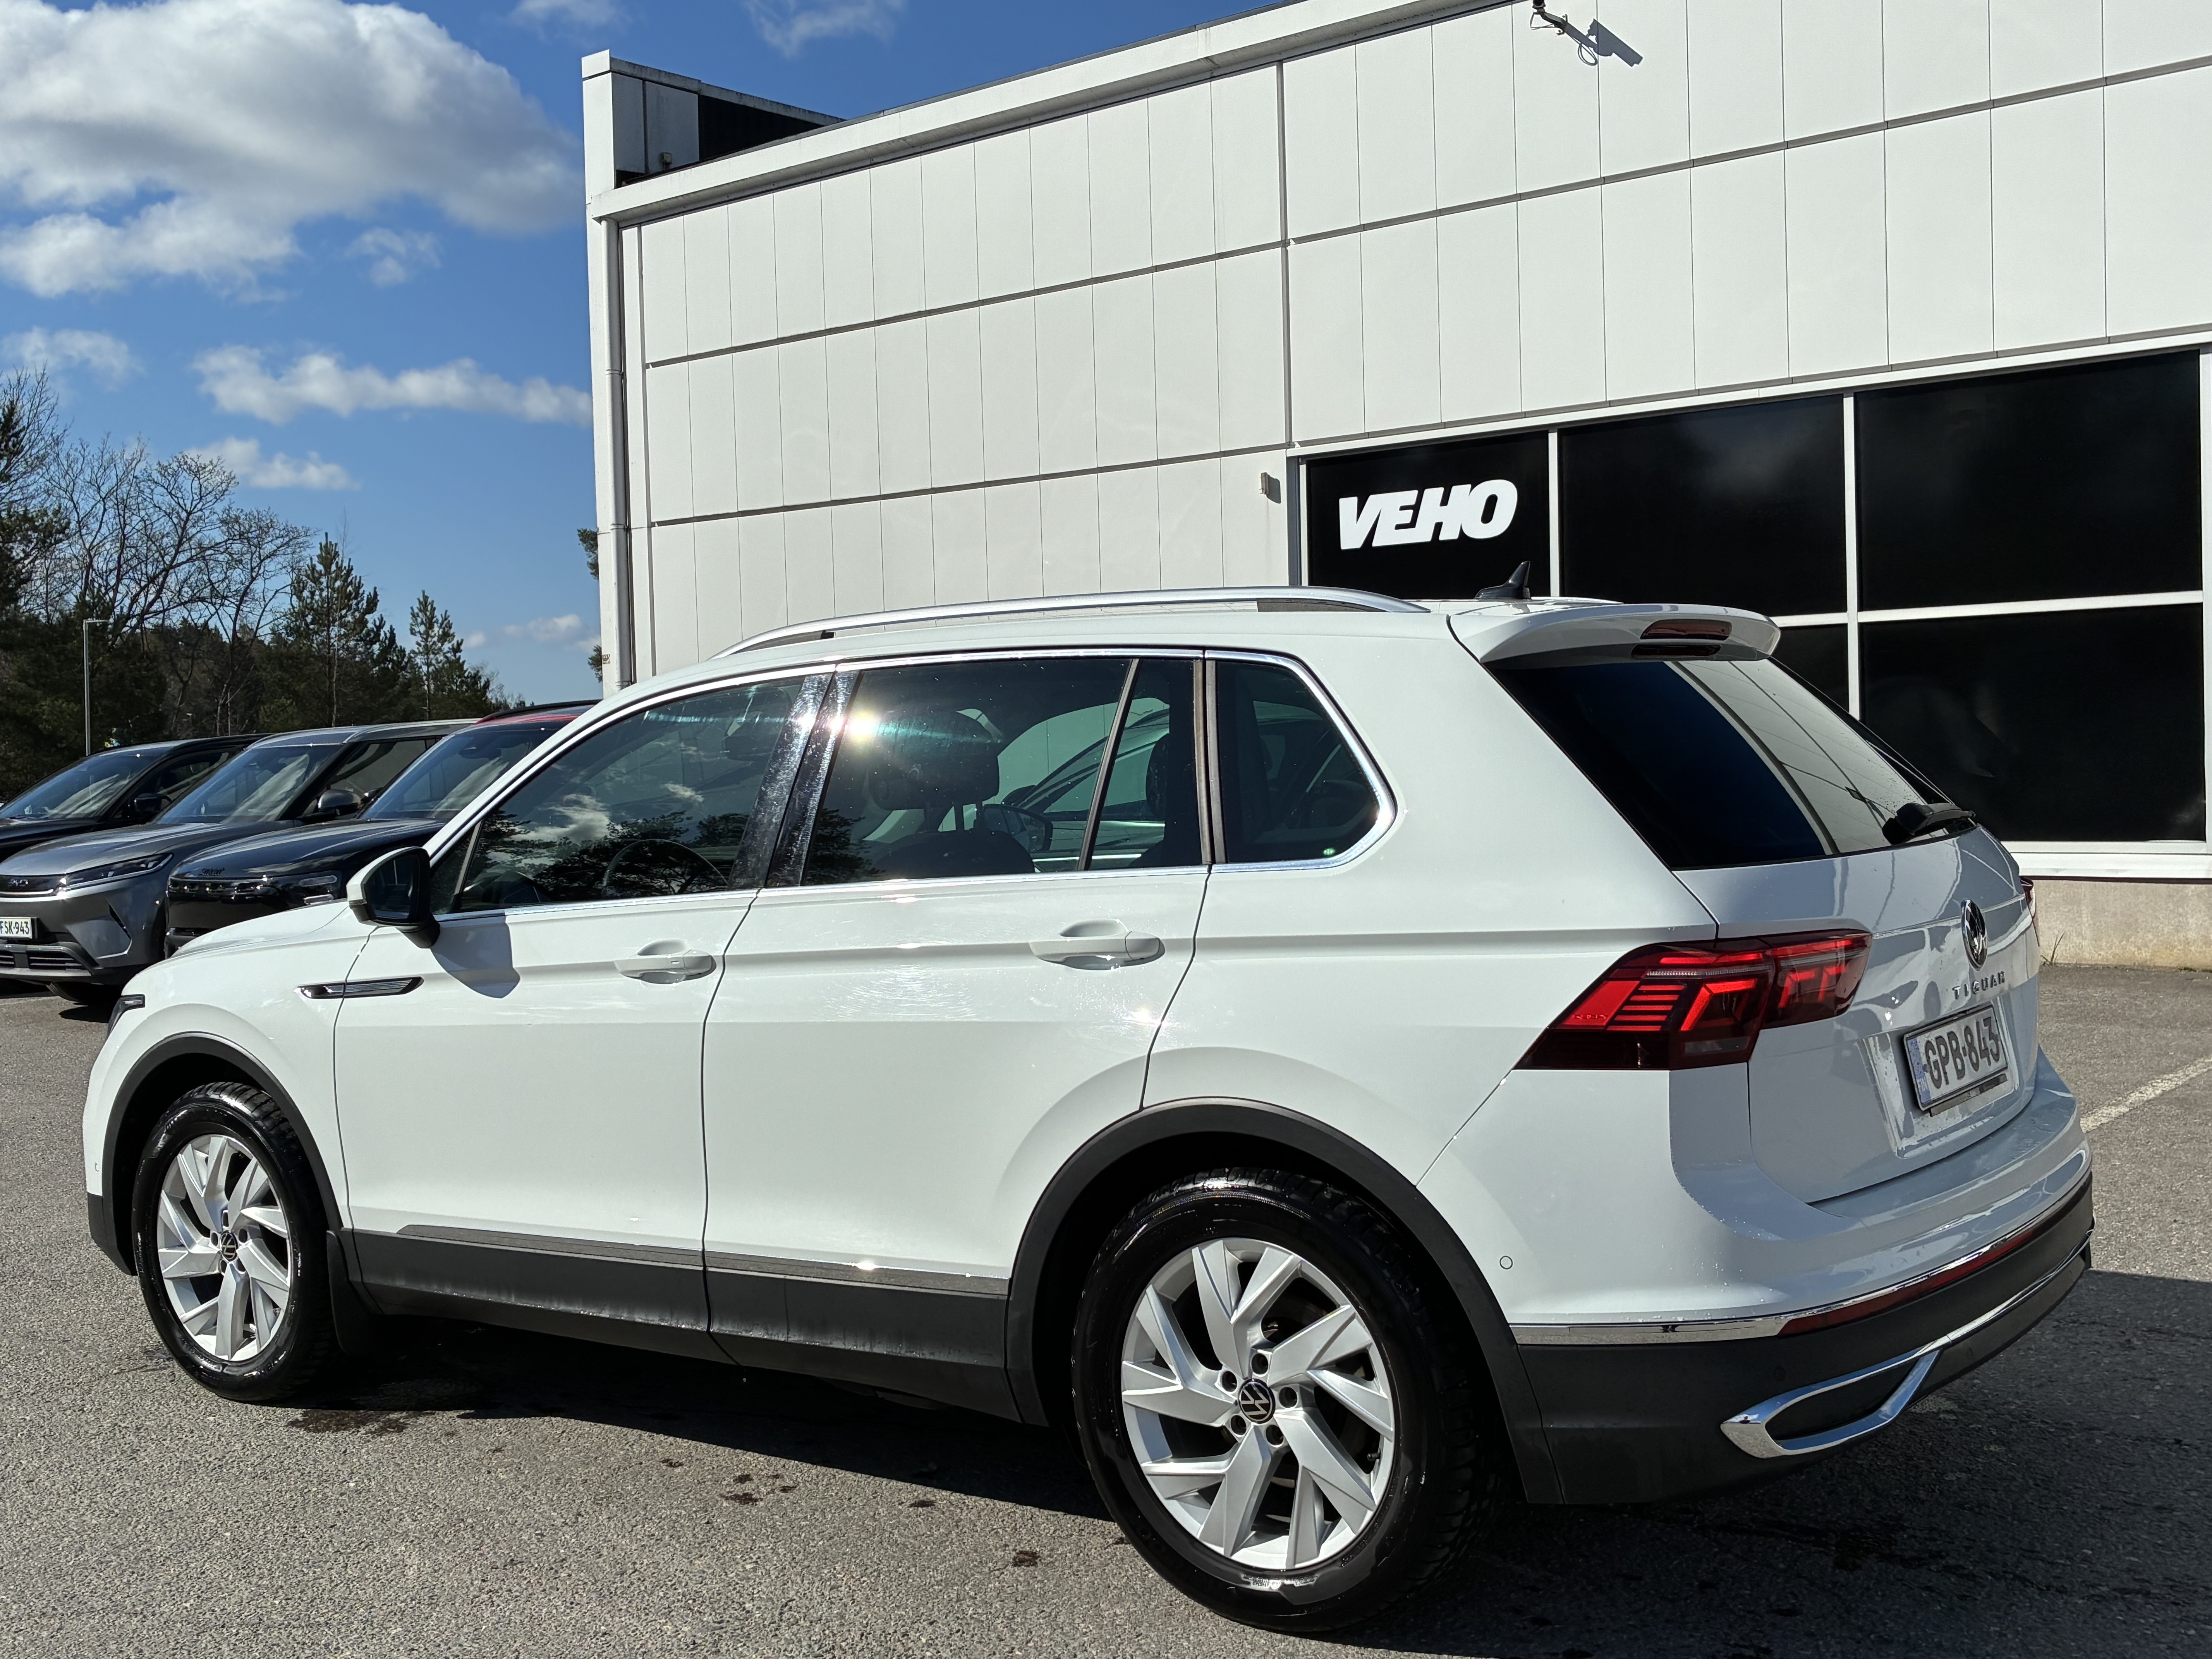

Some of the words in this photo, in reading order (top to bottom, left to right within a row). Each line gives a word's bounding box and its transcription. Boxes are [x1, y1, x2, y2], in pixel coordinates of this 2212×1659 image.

[1339, 479, 1518, 550] VEHO
[0, 921, 29, 935] FSK-943
[1952, 971, 2005, 1000] TIGUAN
[1925, 1016, 2000, 1089] GPB-843
